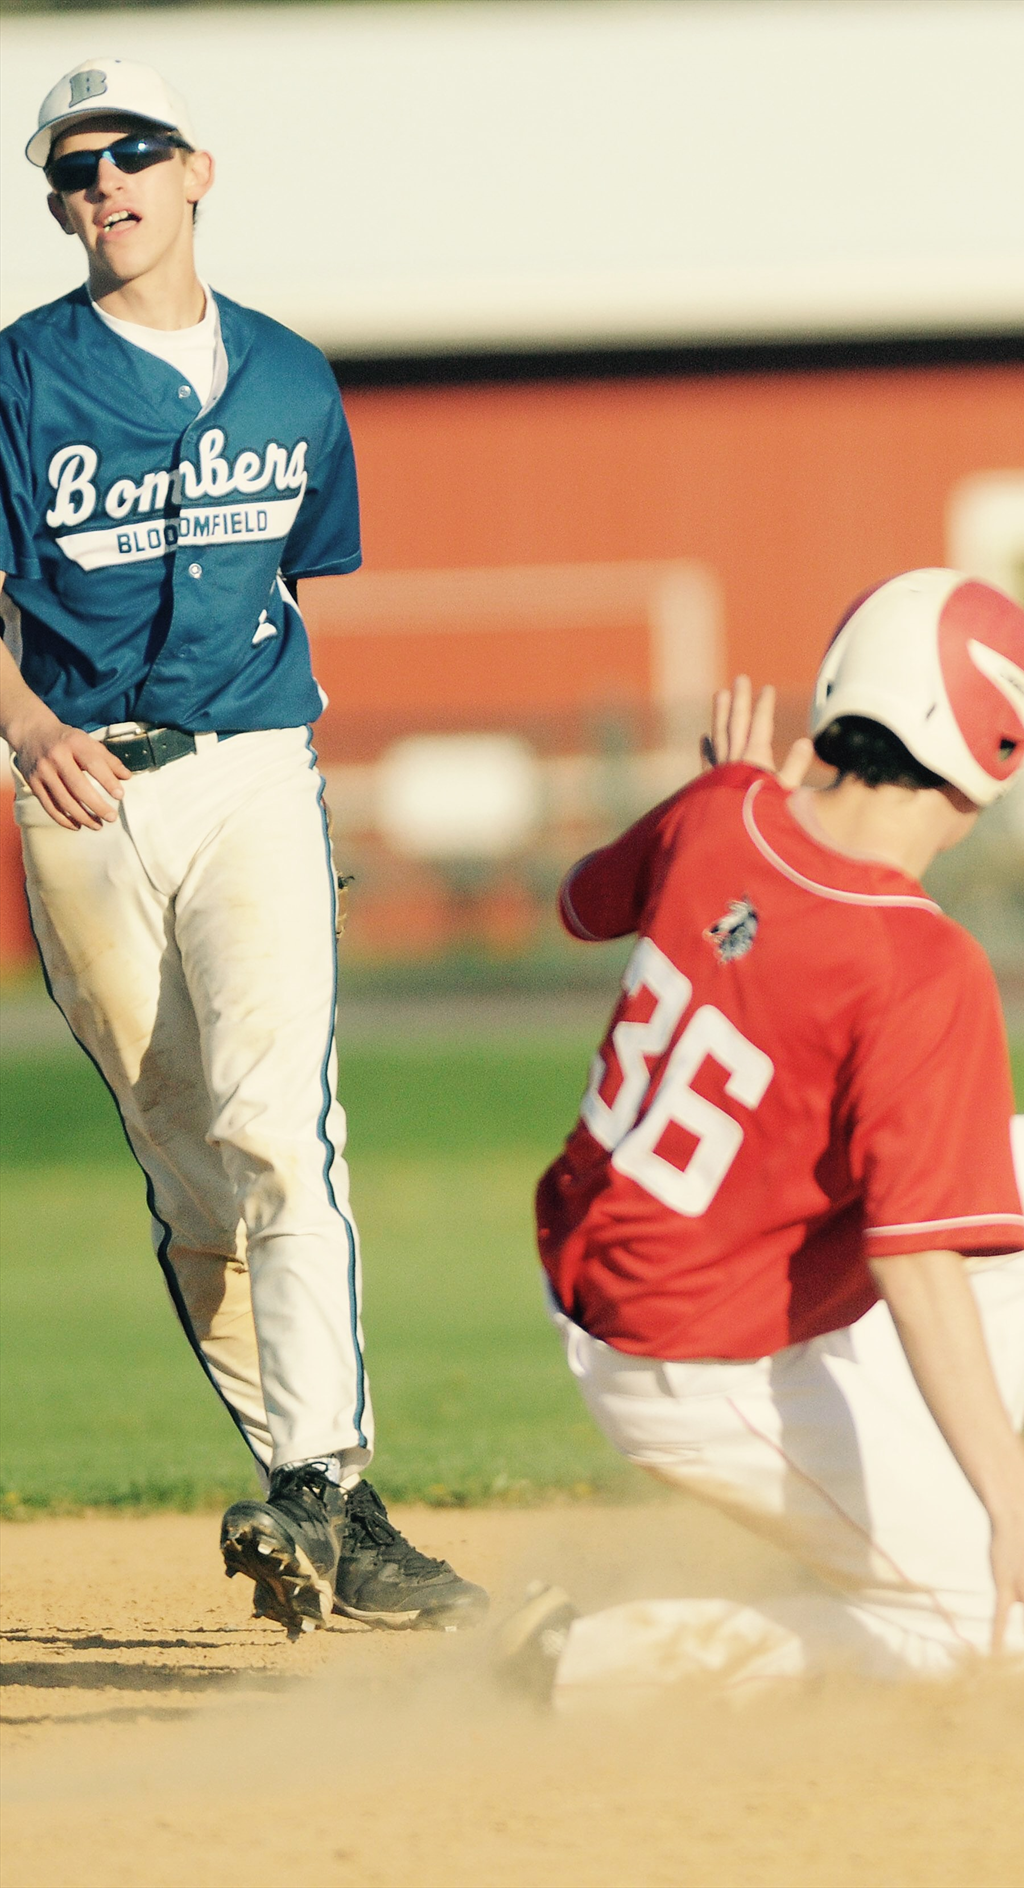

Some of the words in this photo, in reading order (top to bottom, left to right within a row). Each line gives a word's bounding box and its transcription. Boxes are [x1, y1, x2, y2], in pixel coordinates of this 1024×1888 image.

[69, 69, 108, 108] B
[46, 428, 308, 528] Bombers
[581, 936, 775, 1218] 36
